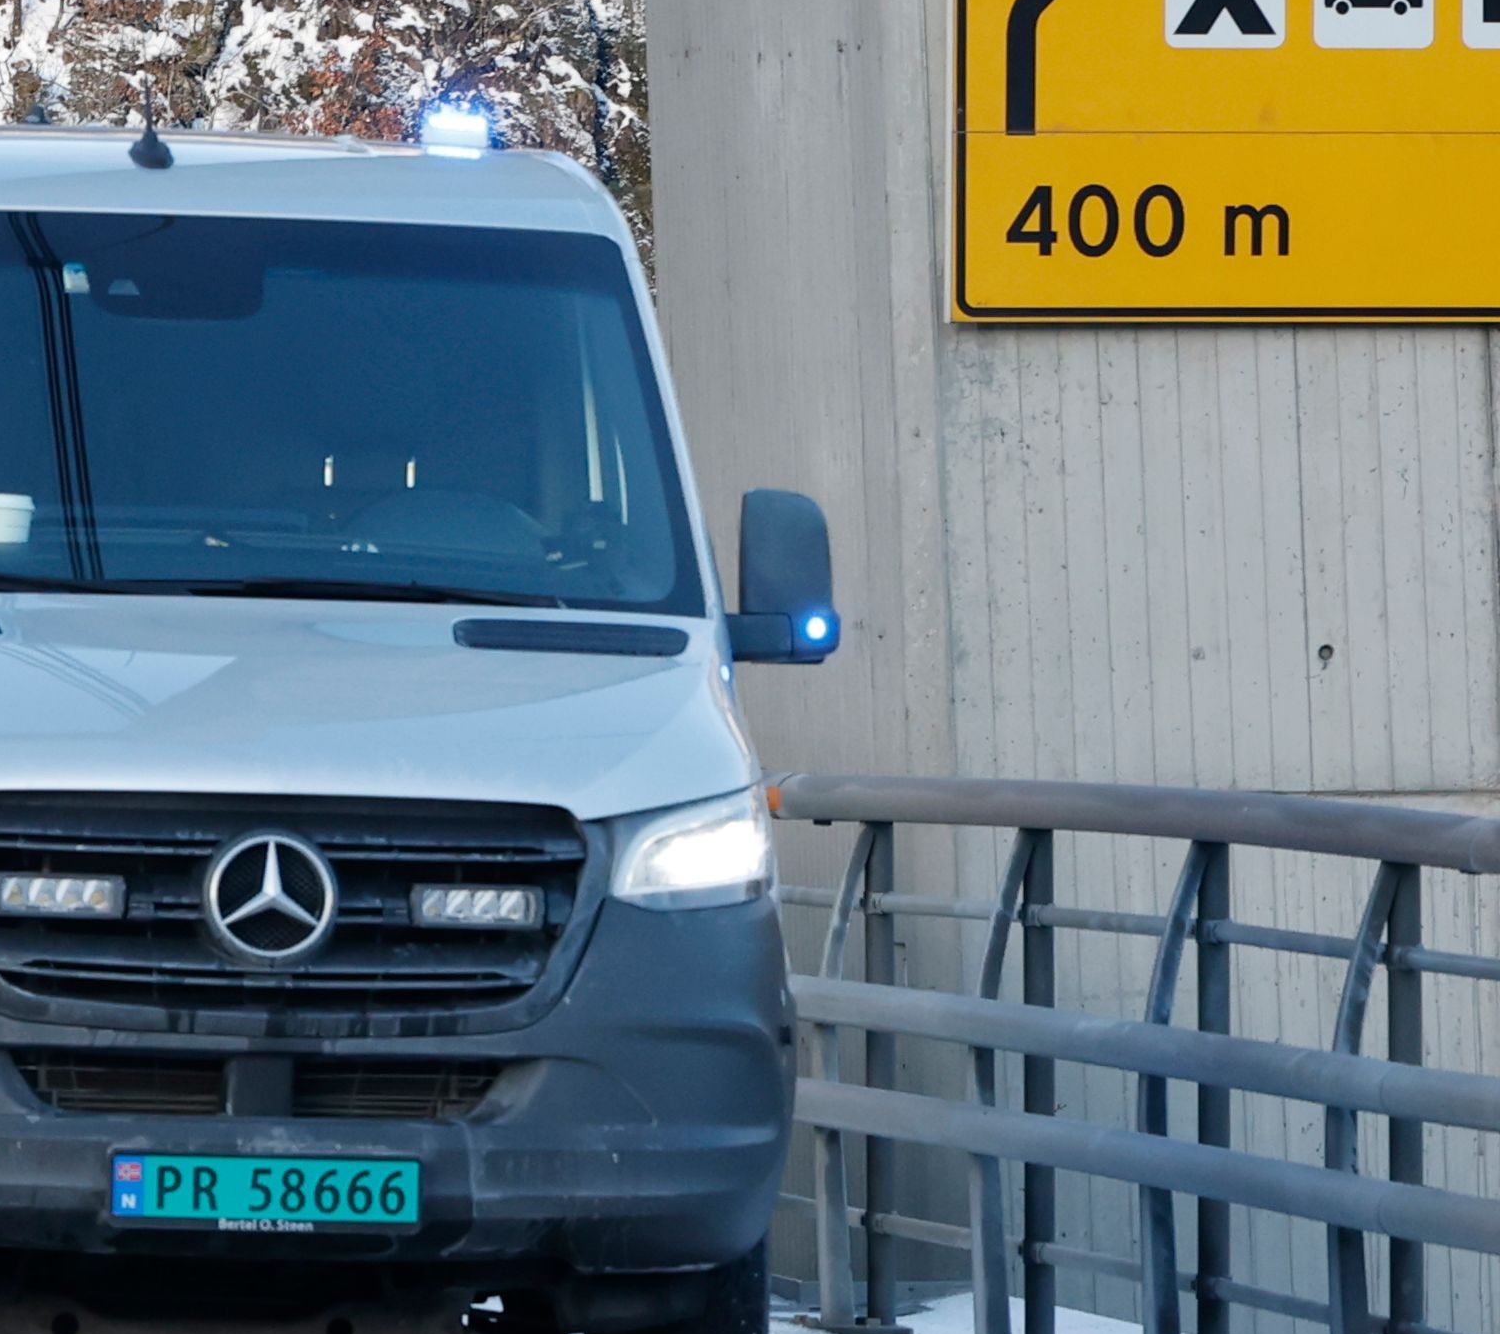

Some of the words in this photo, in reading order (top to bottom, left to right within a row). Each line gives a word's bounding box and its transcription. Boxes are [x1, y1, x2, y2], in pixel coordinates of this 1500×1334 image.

[1006, 183, 1185, 258] 400
[1224, 204, 1290, 256] m
[121, 1193, 137, 1209] N
[156, 1165, 218, 1211] PR
[248, 1167, 406, 1216] 58666
[218, 1217, 257, 1231] Bertel
[276, 1219, 314, 1232] Steen
